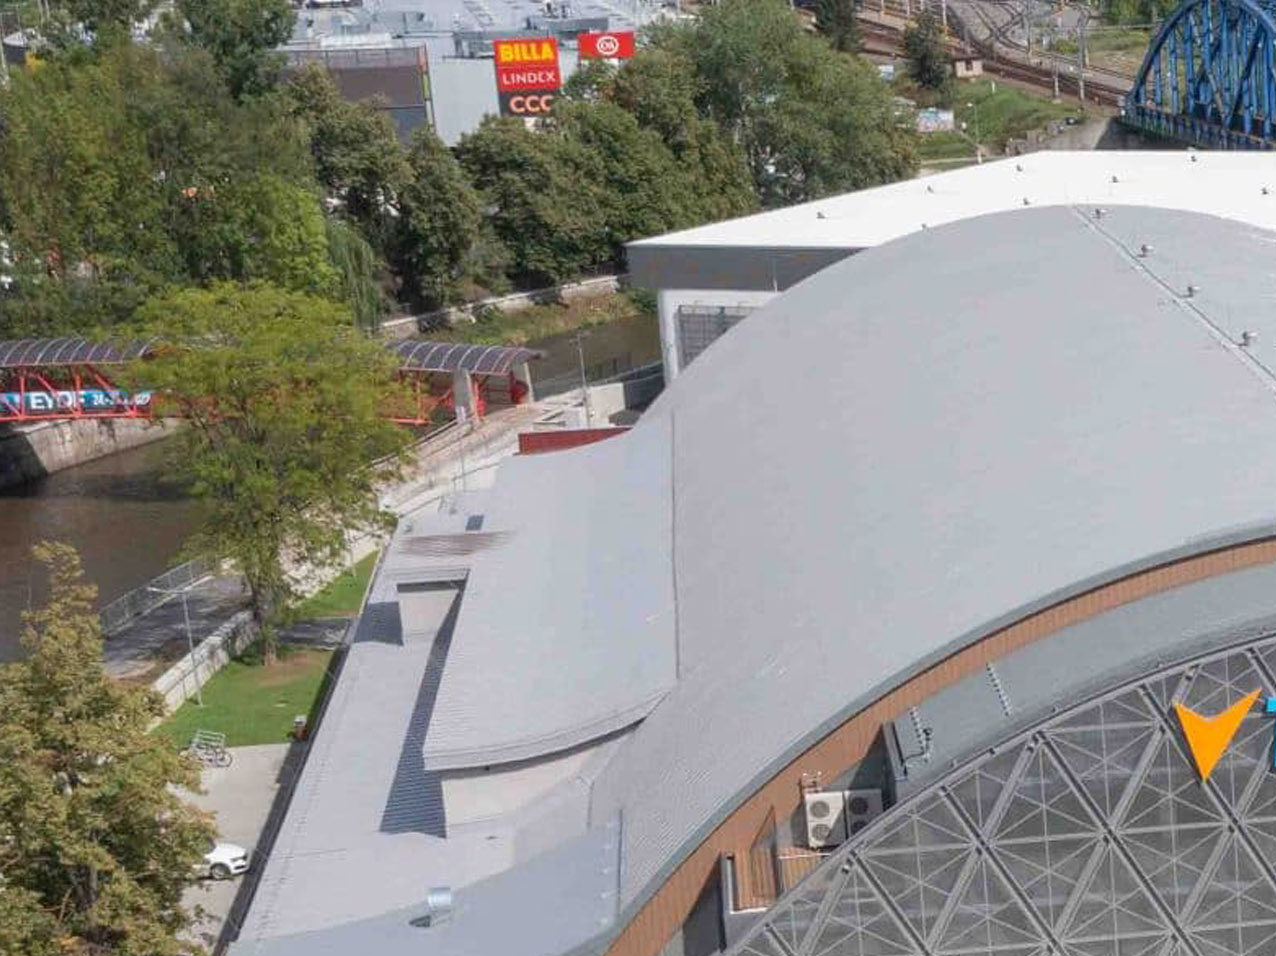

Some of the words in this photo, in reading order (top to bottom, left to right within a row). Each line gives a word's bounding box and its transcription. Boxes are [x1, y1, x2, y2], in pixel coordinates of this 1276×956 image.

[500, 42, 555, 62] BILLA
[502, 71, 556, 85] LINDEX
[509, 95, 554, 113] CCC
